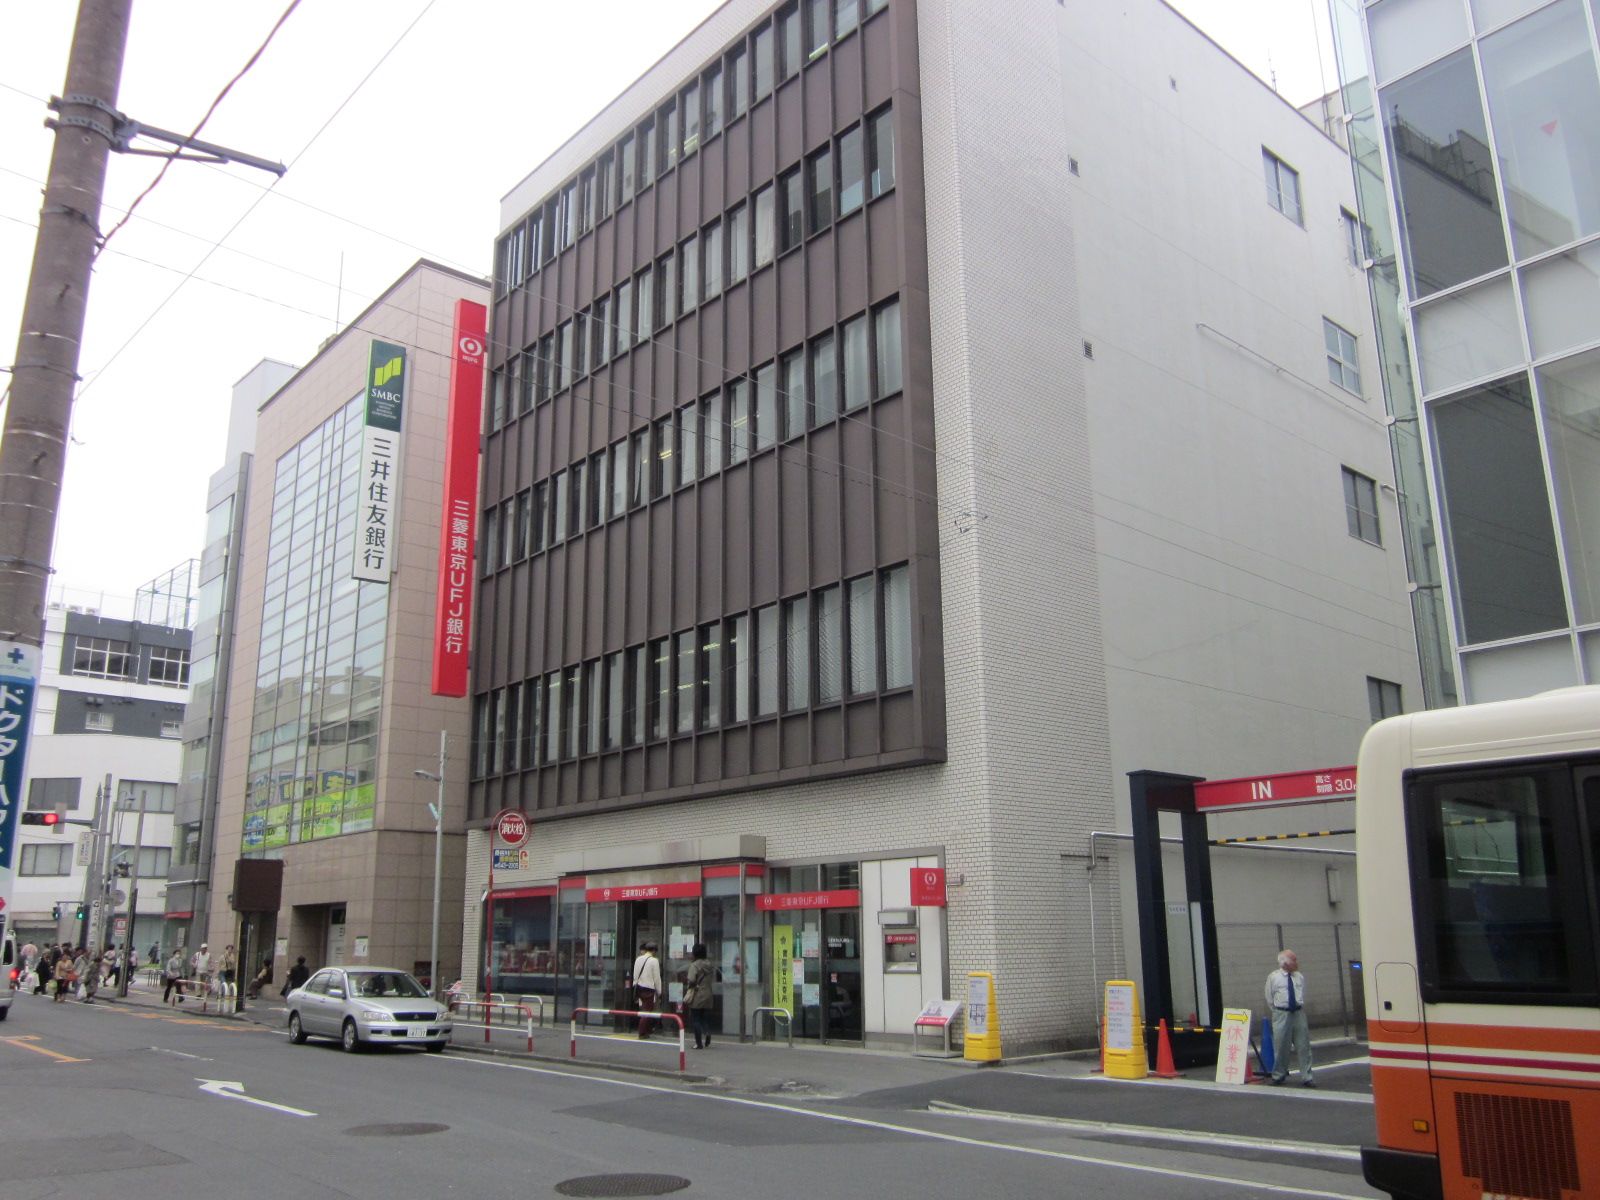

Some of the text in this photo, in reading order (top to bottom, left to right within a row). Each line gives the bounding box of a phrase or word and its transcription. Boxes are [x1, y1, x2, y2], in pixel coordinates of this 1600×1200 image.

[371, 388, 401, 403] SMBC
[363, 437, 392, 570] 三井住友銀行
[445, 499, 470, 654] 三菱東京UFJ銀行
[1251, 780, 1273, 800] IN
[501, 823, 524, 835] 消火栓
[1224, 1025, 1244, 1082] 休業中
